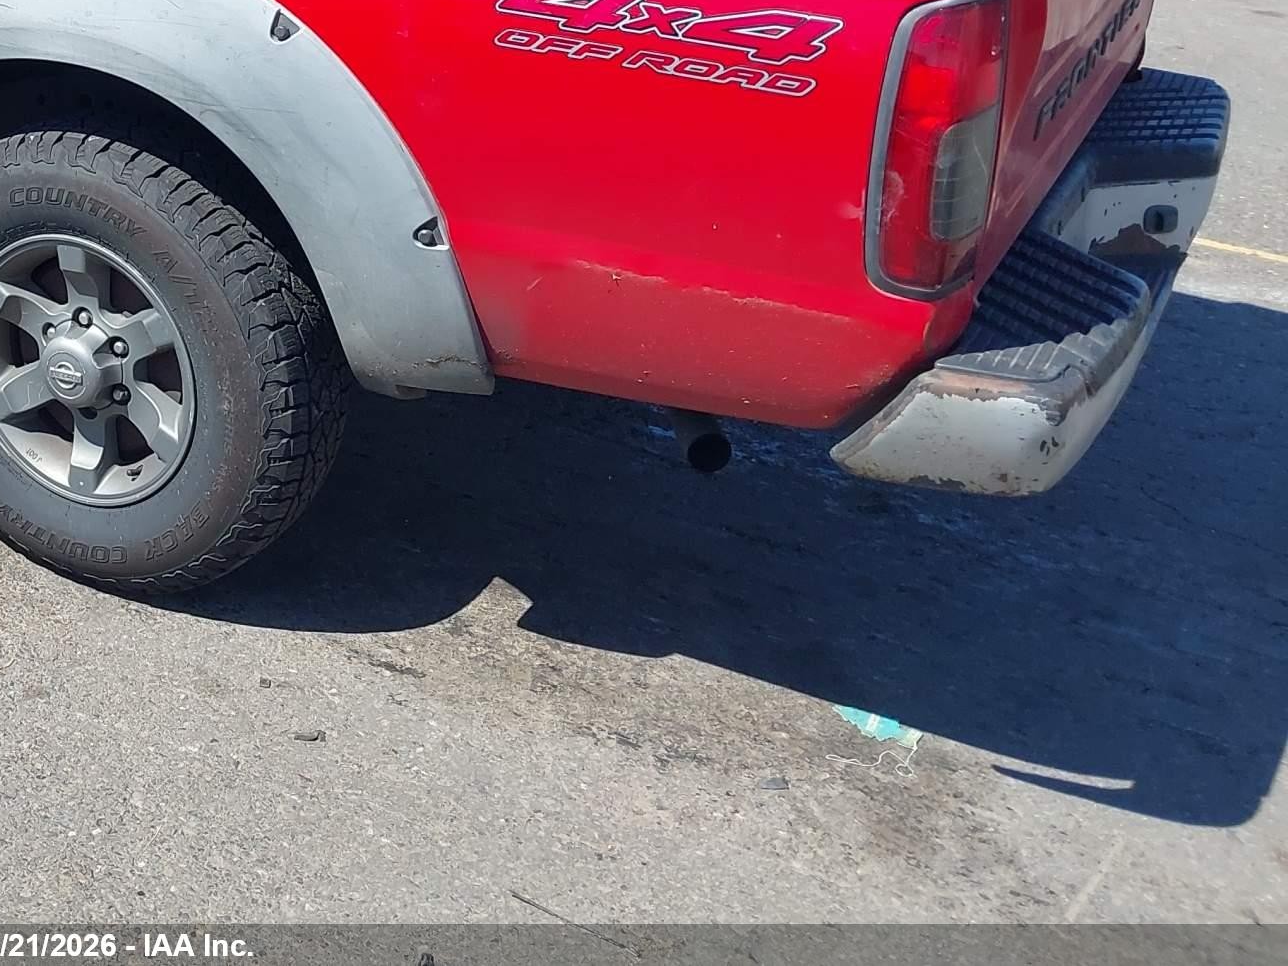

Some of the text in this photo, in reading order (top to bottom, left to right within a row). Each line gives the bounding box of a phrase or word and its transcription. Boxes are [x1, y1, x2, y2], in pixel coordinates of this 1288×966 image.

[493, 27, 817, 98] OFF ROAD
[9, 186, 148, 237] COUNTRY
[144, 500, 210, 563] BACK
